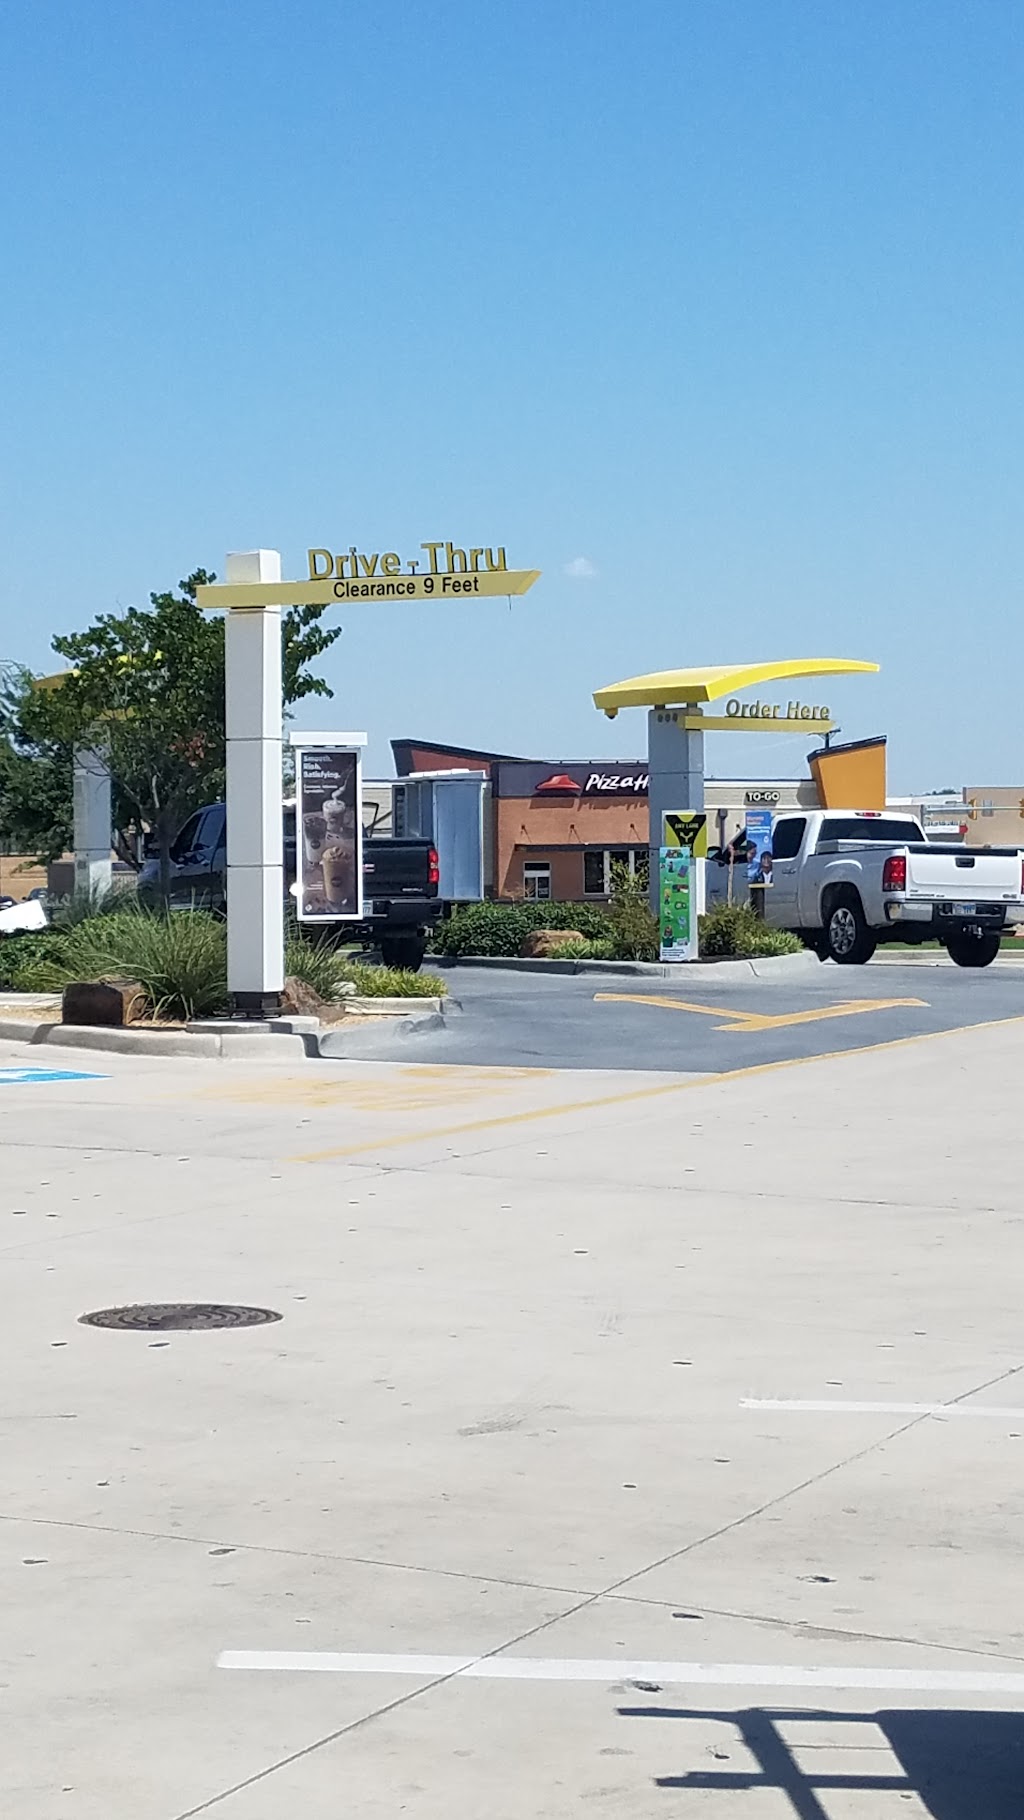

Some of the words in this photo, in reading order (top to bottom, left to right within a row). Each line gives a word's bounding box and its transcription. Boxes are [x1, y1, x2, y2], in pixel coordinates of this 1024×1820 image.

[333, 581, 415, 598] Clearance
[423, 577, 435, 594] 9
[442, 576, 479, 593] Feet
[725, 698, 781, 719] Order
[786, 700, 830, 719] Here
[585, 773, 634, 791] Pizza
[633, 773, 650, 791] H
[747, 791, 780, 801] TO-GO
